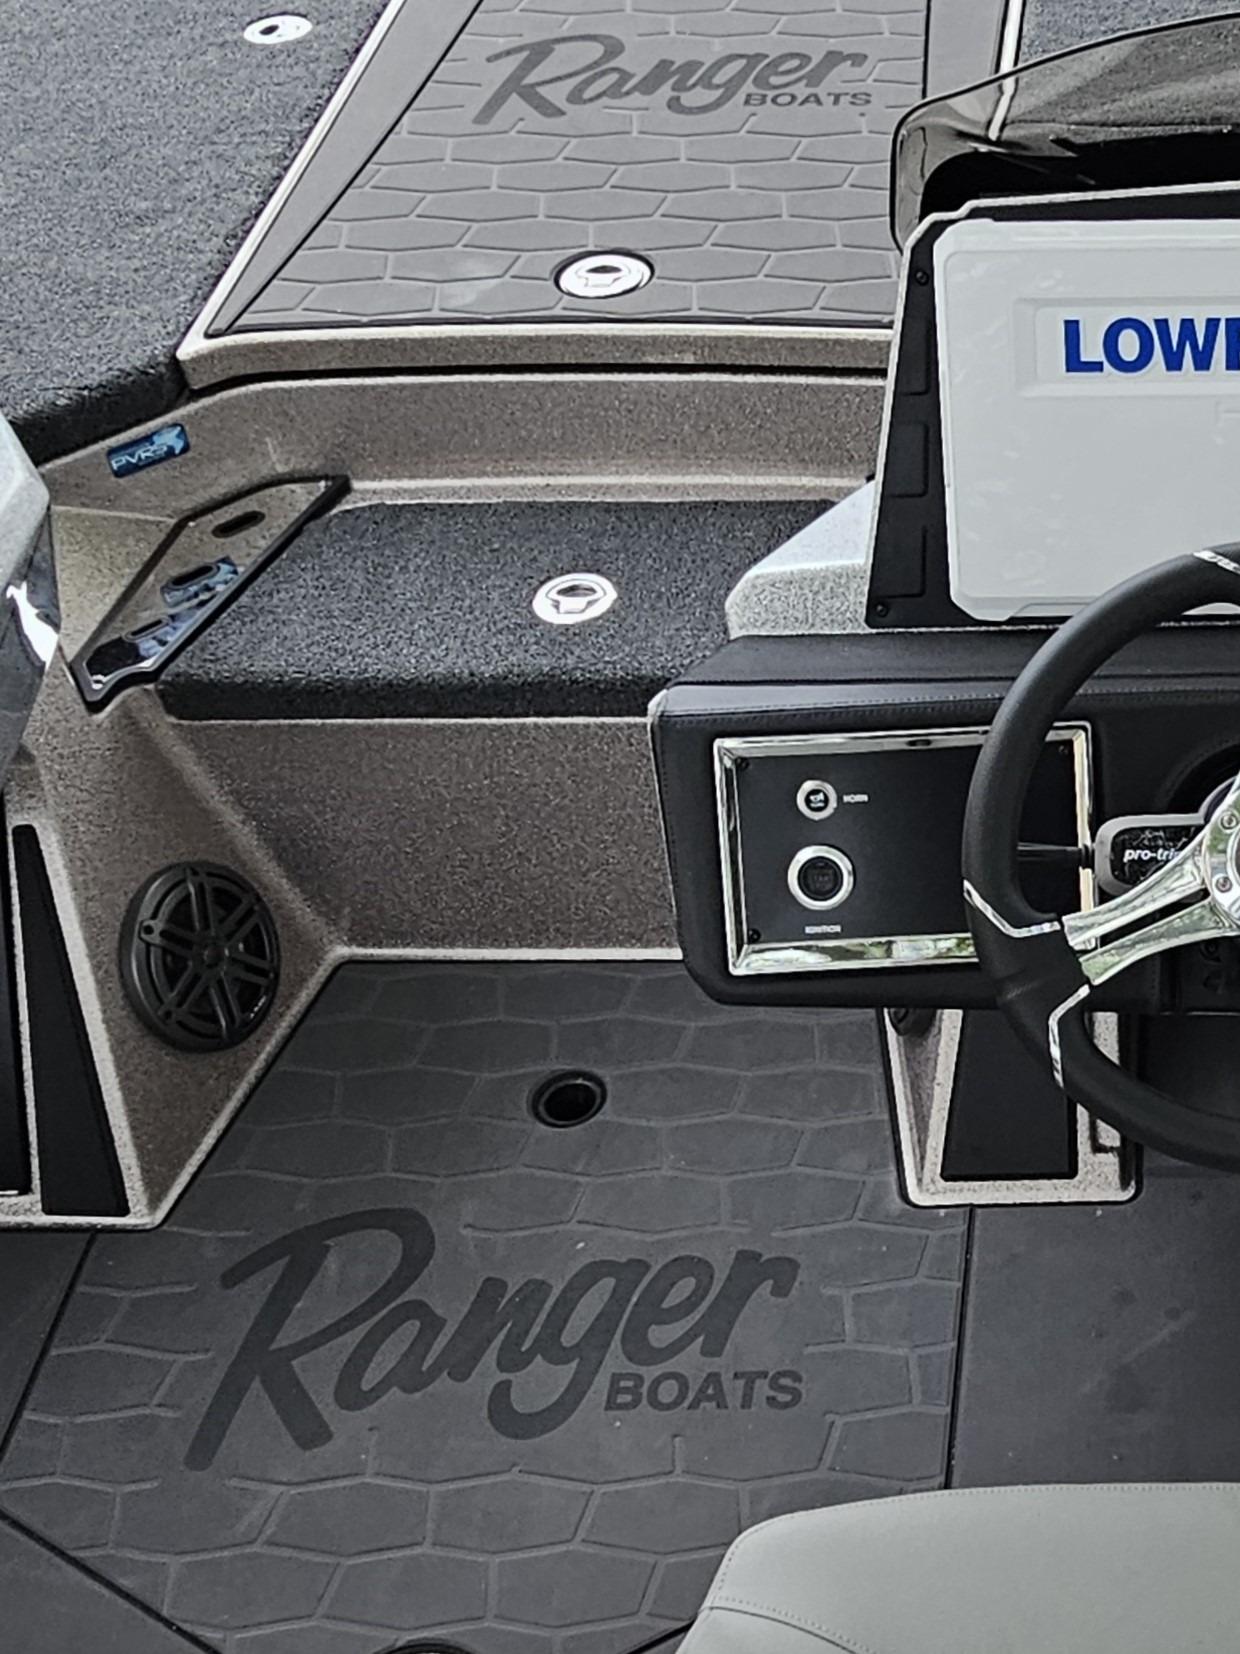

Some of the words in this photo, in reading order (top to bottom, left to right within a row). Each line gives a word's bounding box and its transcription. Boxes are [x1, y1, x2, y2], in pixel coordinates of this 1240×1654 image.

[472, 33, 869, 125] Ranger
[743, 91, 873, 107] BOATS
[182, 1206, 800, 1472] Ranger
[603, 1369, 804, 1413] BOATS
